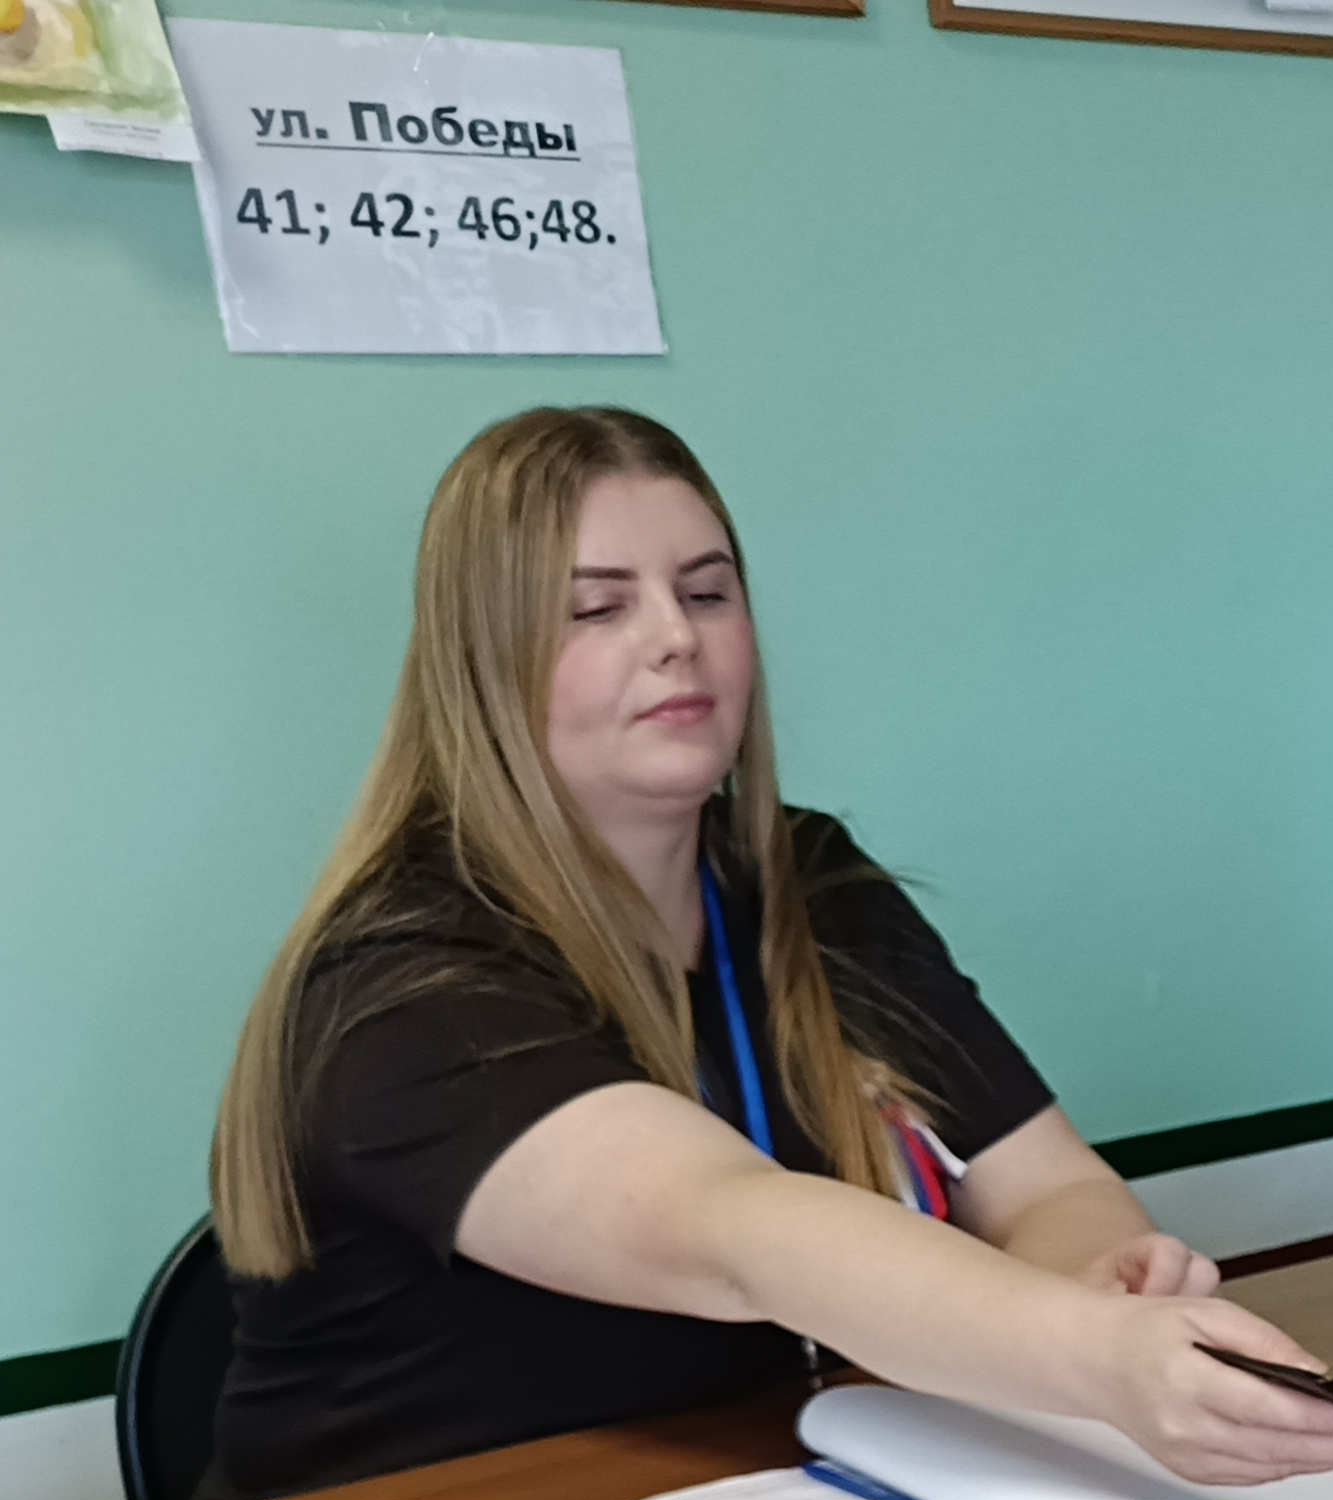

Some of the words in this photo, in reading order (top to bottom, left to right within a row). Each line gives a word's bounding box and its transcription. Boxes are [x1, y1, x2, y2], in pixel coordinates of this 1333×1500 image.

[250, 106, 329, 140] ул.
[347, 101, 578, 155] Победы
[236, 187, 331, 245] 41;
[349, 192, 441, 249] 42;
